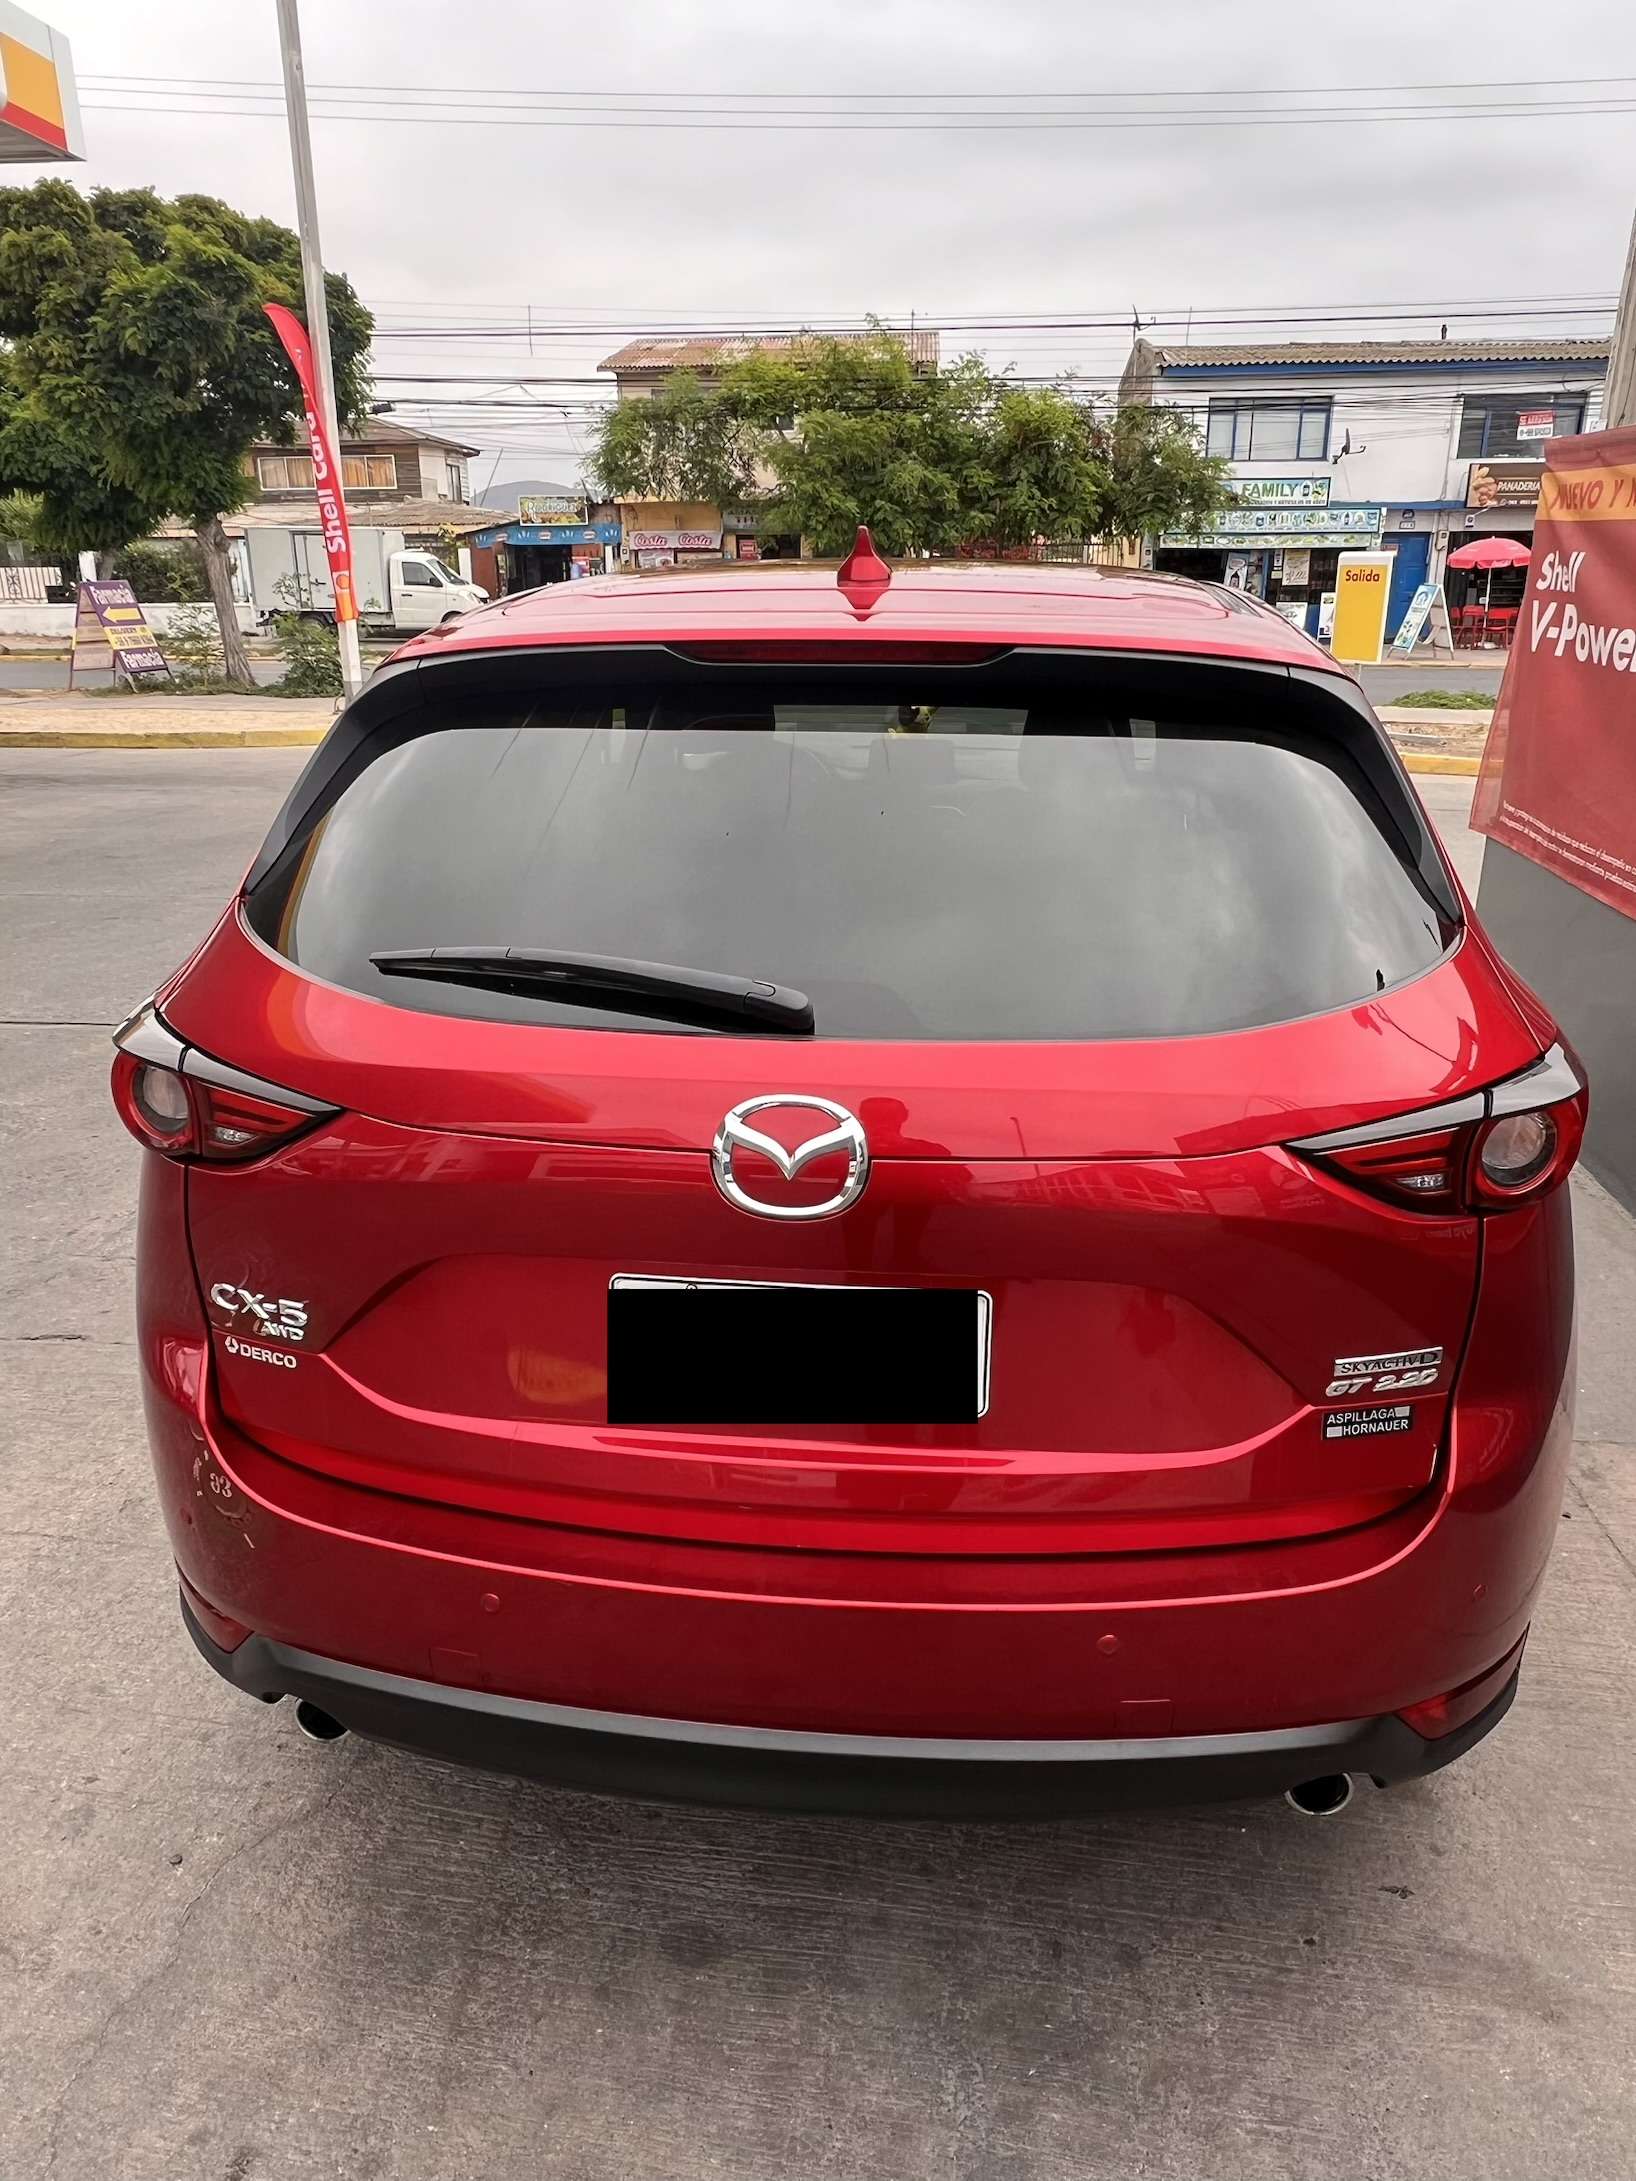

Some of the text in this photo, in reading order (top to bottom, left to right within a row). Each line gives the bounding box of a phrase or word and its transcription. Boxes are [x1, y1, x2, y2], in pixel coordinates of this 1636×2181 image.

[1241, 483, 1298, 498] FAMILY
[1497, 481, 1540, 491] PANADERIA
[1551, 479, 1604, 510] NUEVO
[1608, 478, 1625, 508] Y
[317, 488, 346, 554] Shell
[634, 532, 713, 546] Costa Costa
[1345, 568, 1380, 583] Salida
[1536, 550, 1586, 593] Shell
[1531, 600, 1636, 673] V-Powe
[210, 1283, 308, 1327] CX-5
[260, 1321, 304, 1341] AWD
[240, 1343, 297, 1369] DERCO
[1325, 1376, 1373, 1397] GT
[1327, 1408, 1396, 1425] ASPILLAGA
[1343, 1419, 1408, 1436] HORNAUER
